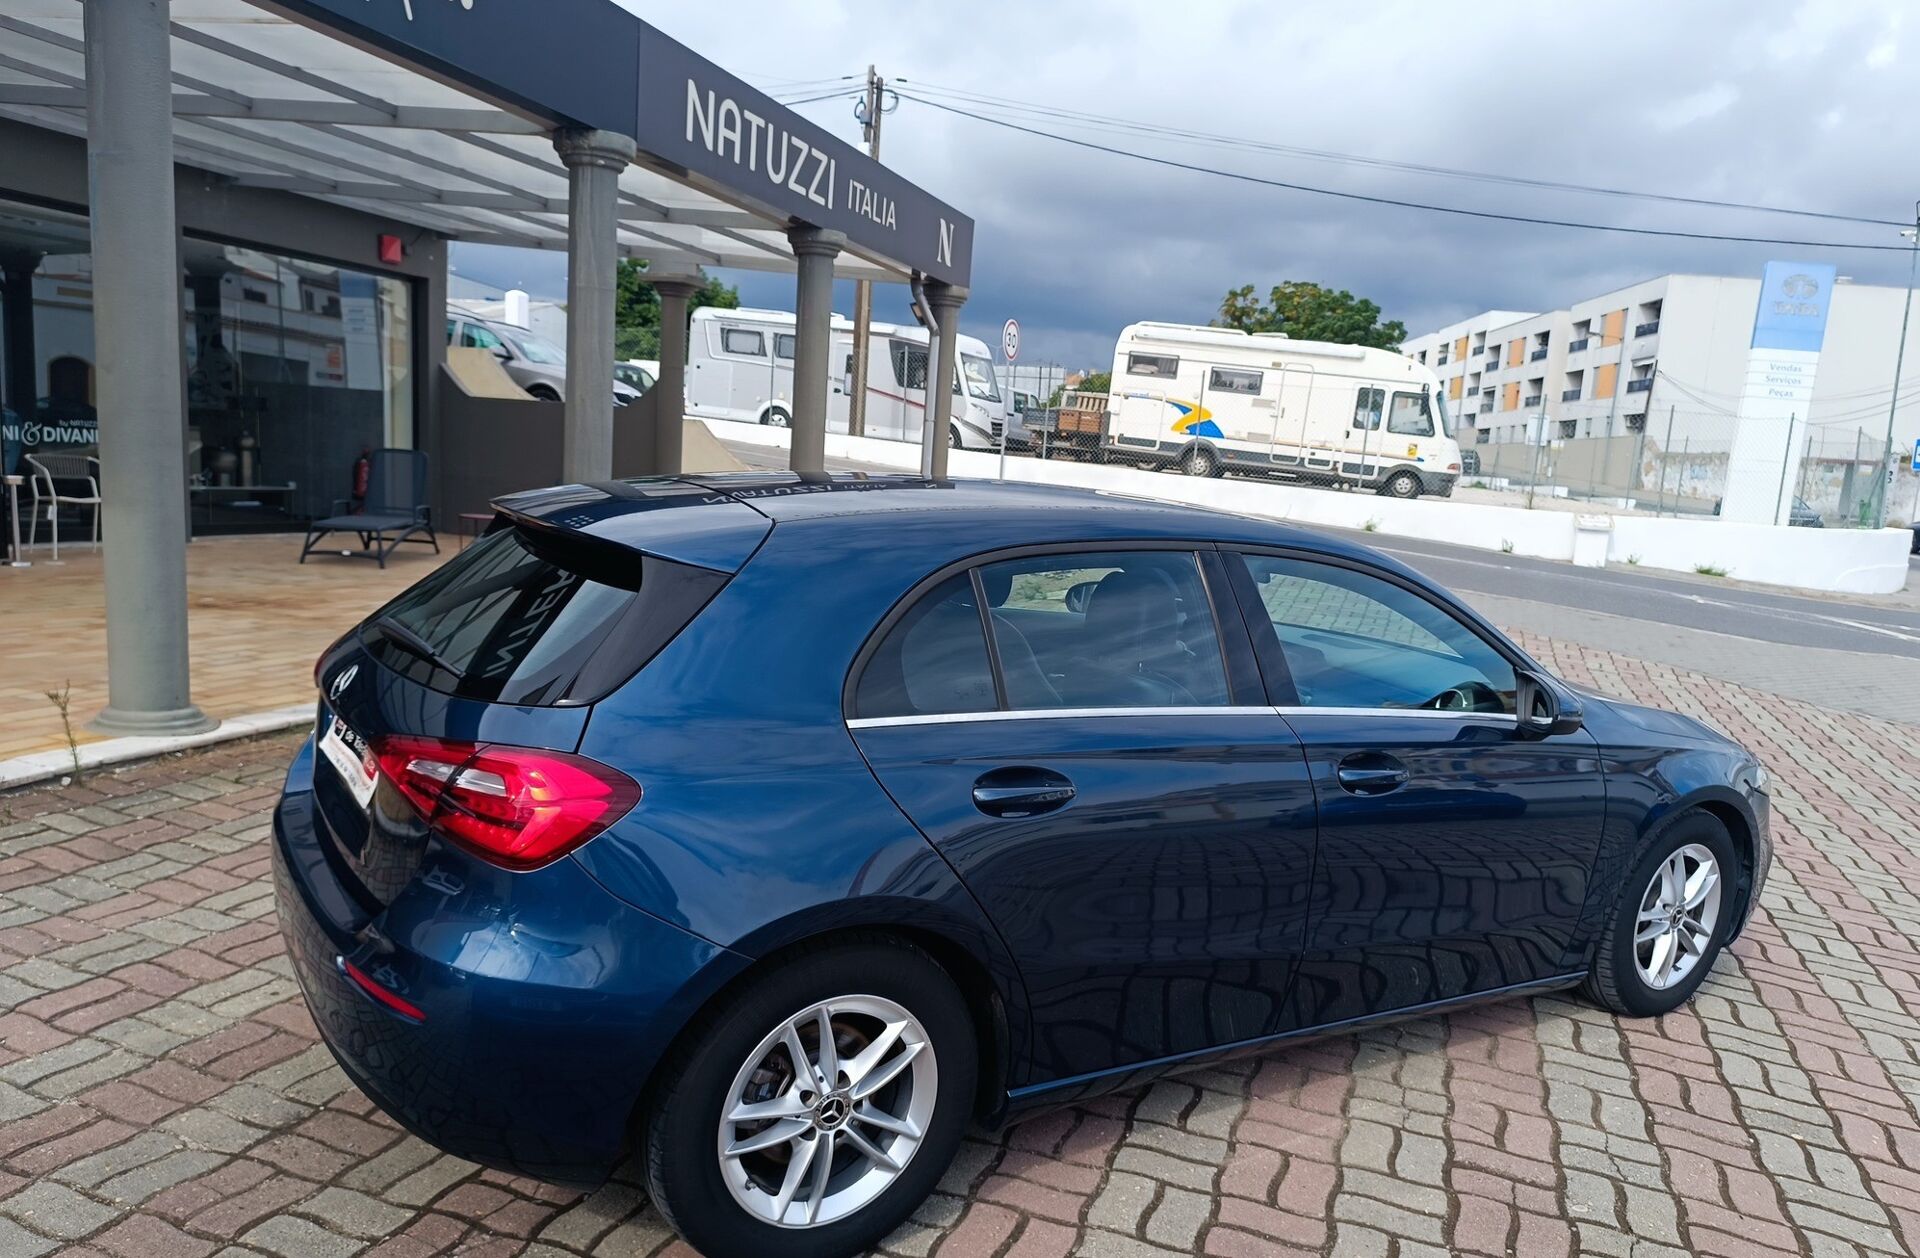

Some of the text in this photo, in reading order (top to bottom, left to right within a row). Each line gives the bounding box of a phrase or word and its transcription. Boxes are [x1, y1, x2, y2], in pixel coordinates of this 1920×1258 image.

[686, 78, 897, 231] NATUZZI ITALIA
[936, 217, 955, 268] N
[1007, 332, 1017, 349] 30
[1769, 362, 1802, 373] Vendas
[1766, 375, 1802, 386] Serviços
[1768, 388, 1794, 397] Peças
[43, 426, 99, 443] DIVANI
